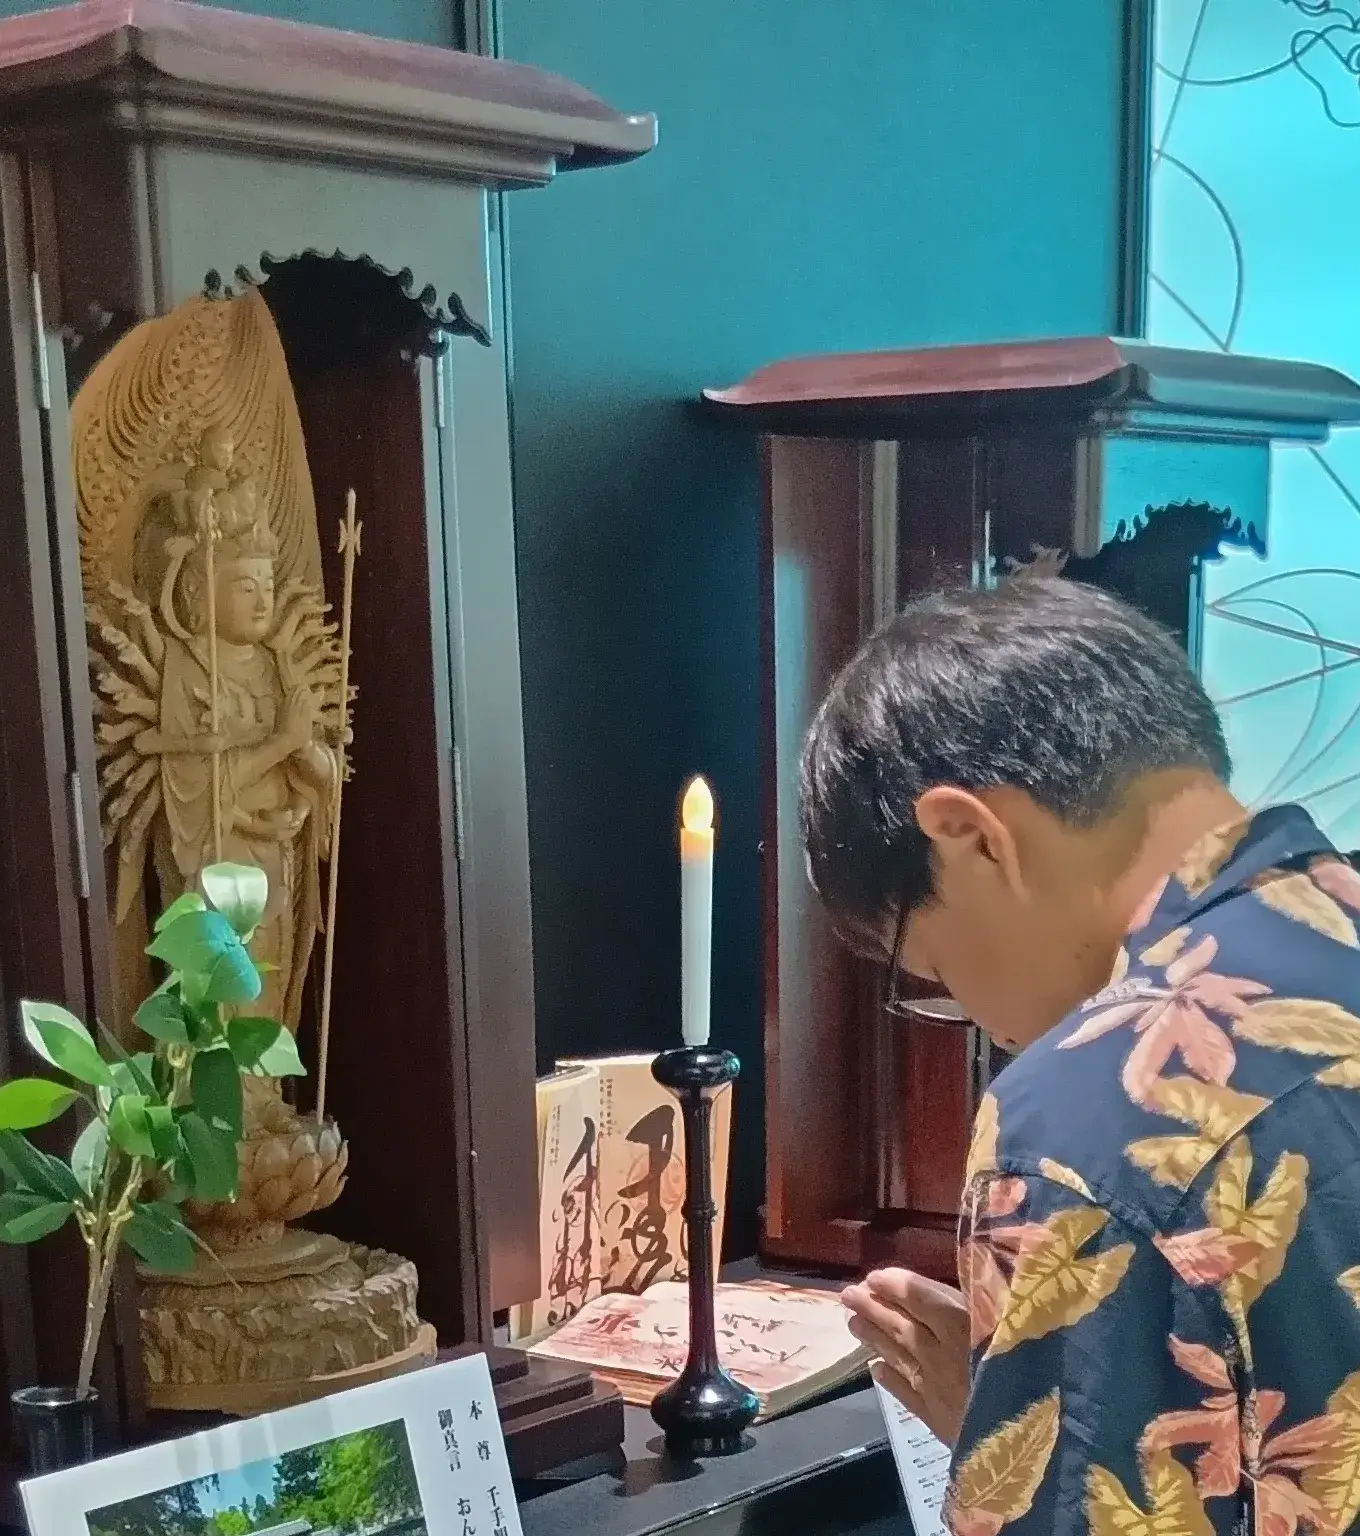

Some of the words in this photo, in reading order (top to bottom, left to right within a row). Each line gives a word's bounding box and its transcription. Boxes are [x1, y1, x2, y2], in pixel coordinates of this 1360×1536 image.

[437, 1409, 462, 1472] 御真言
[456, 1497, 476, 1536] おん
